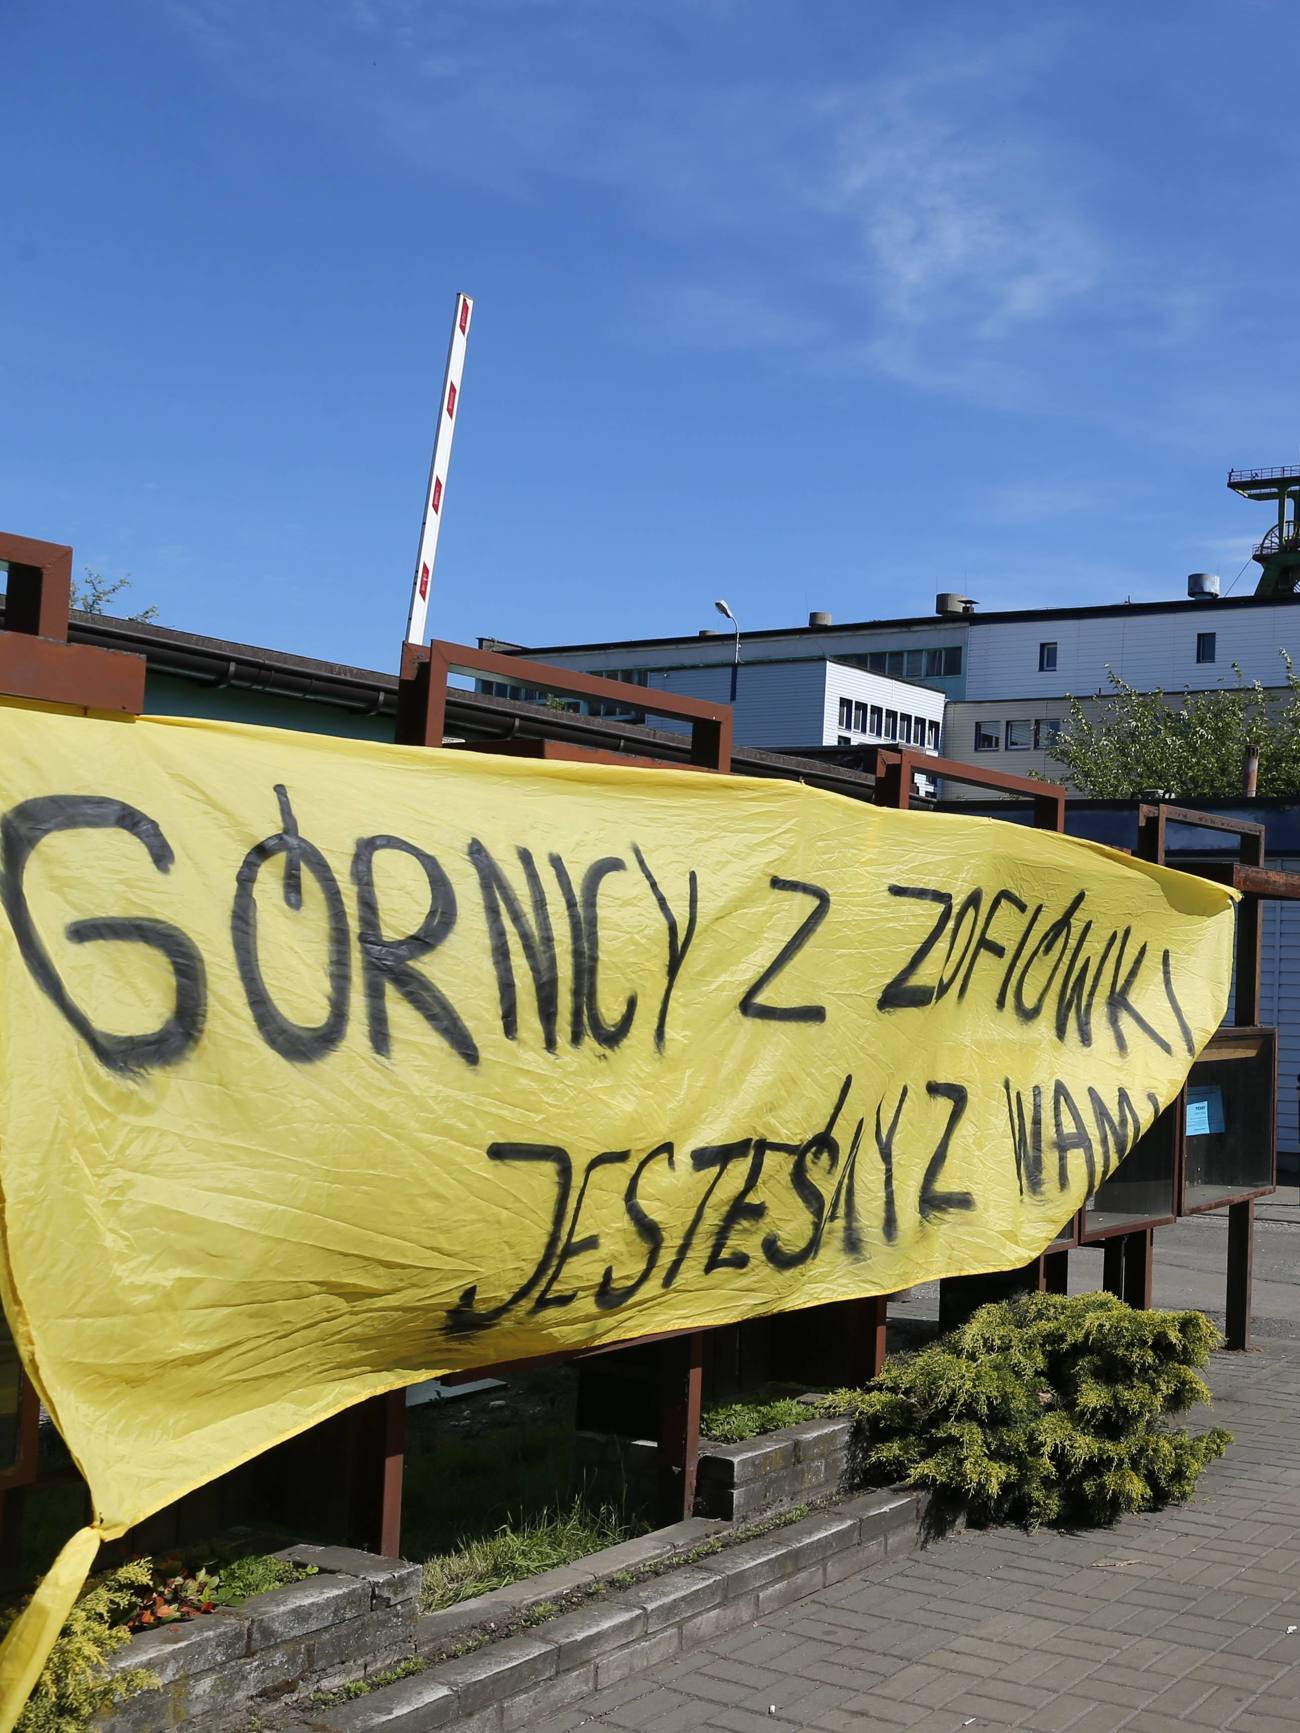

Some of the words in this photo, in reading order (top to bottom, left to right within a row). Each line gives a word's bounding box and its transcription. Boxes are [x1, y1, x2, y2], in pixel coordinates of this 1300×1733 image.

[0, 783, 698, 1080] GÓRNICY
[738, 874, 831, 1024] Z
[876, 885, 1196, 1057] ZOFIÓWKI
[918, 1080, 977, 1221] Z
